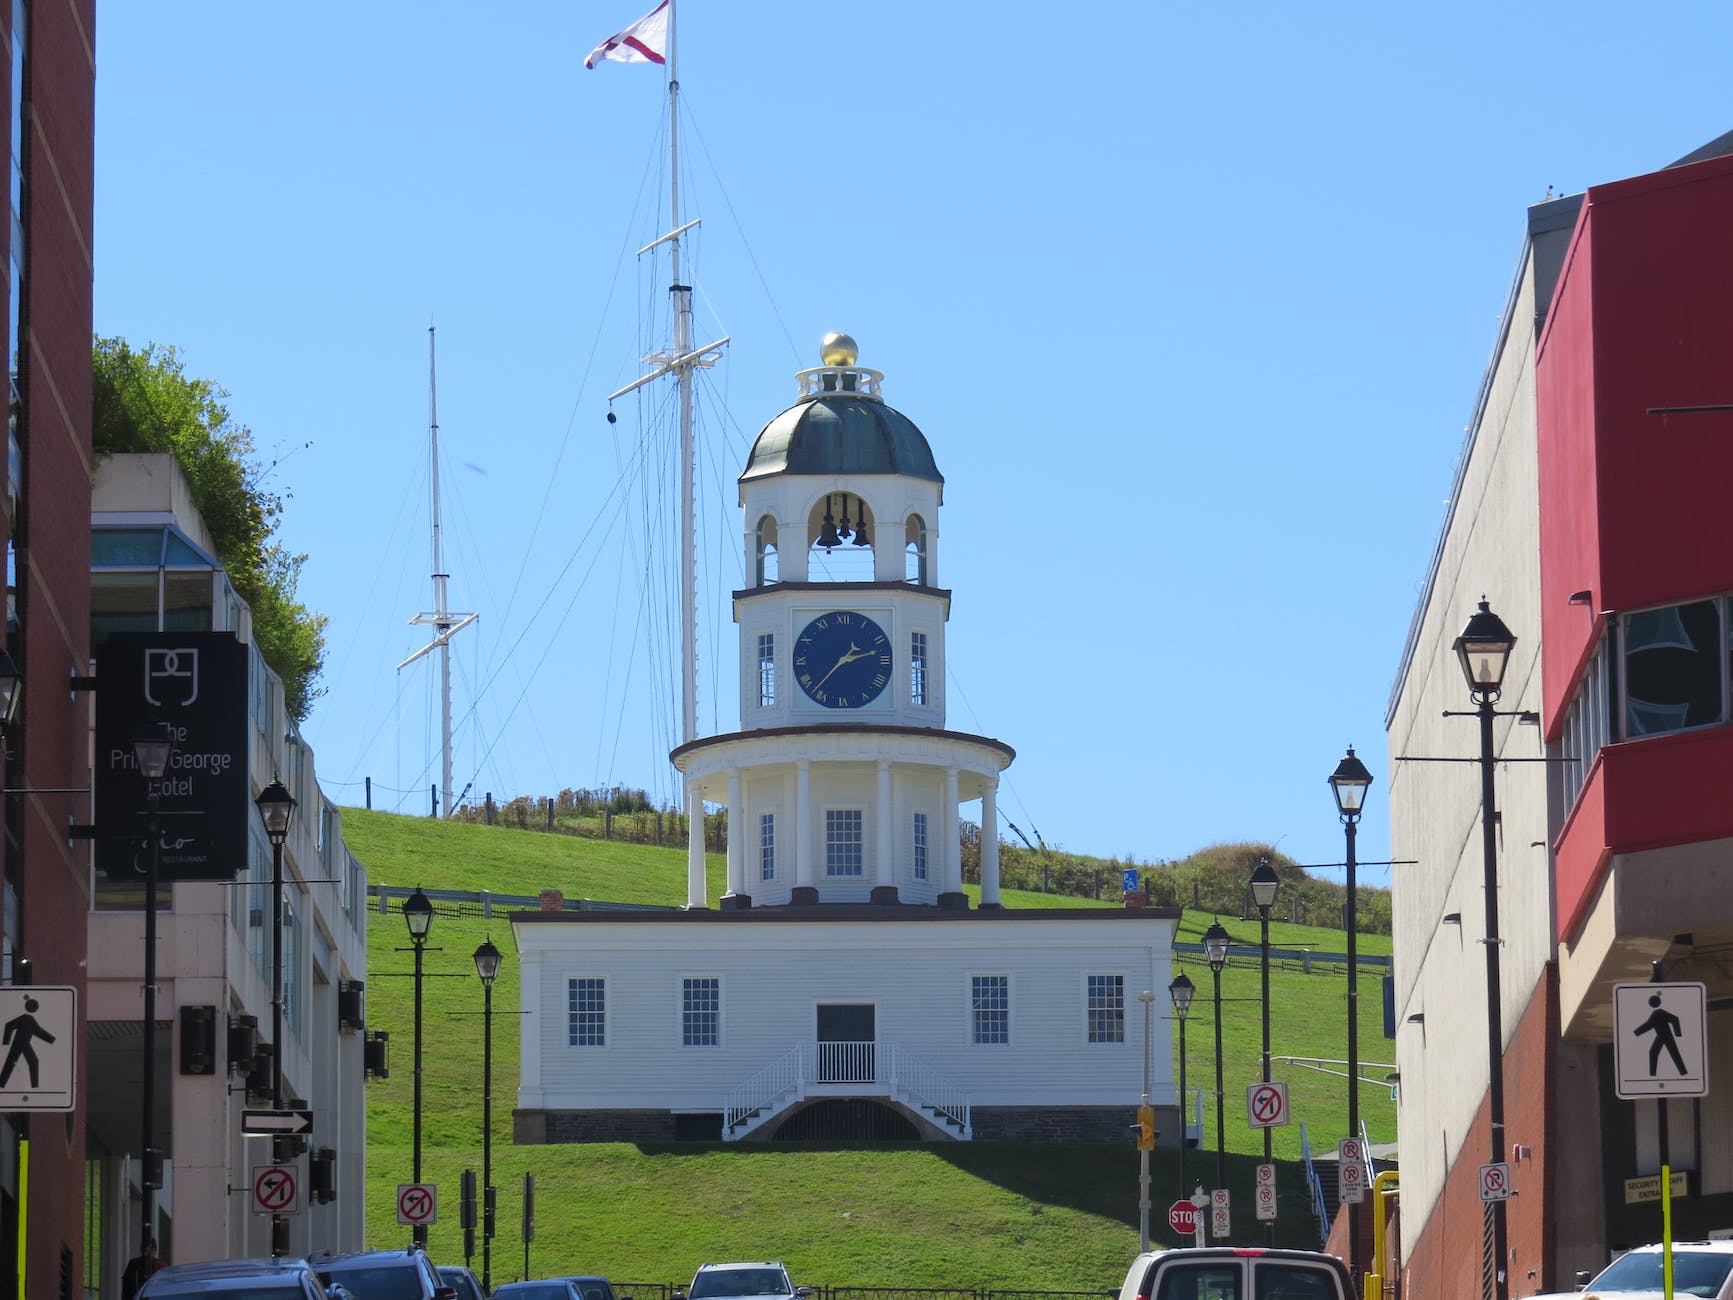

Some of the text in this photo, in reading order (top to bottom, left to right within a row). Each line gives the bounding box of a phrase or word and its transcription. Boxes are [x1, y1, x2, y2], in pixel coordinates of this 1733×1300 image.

[816, 620, 828, 630] XI
[838, 616, 850, 624] XII
[801, 636, 812, 644] X
[874, 634, 884, 644] II
[880, 656, 890, 664] III
[170, 748, 232, 776] George
[1628, 1180, 1659, 1190] SECURITY
